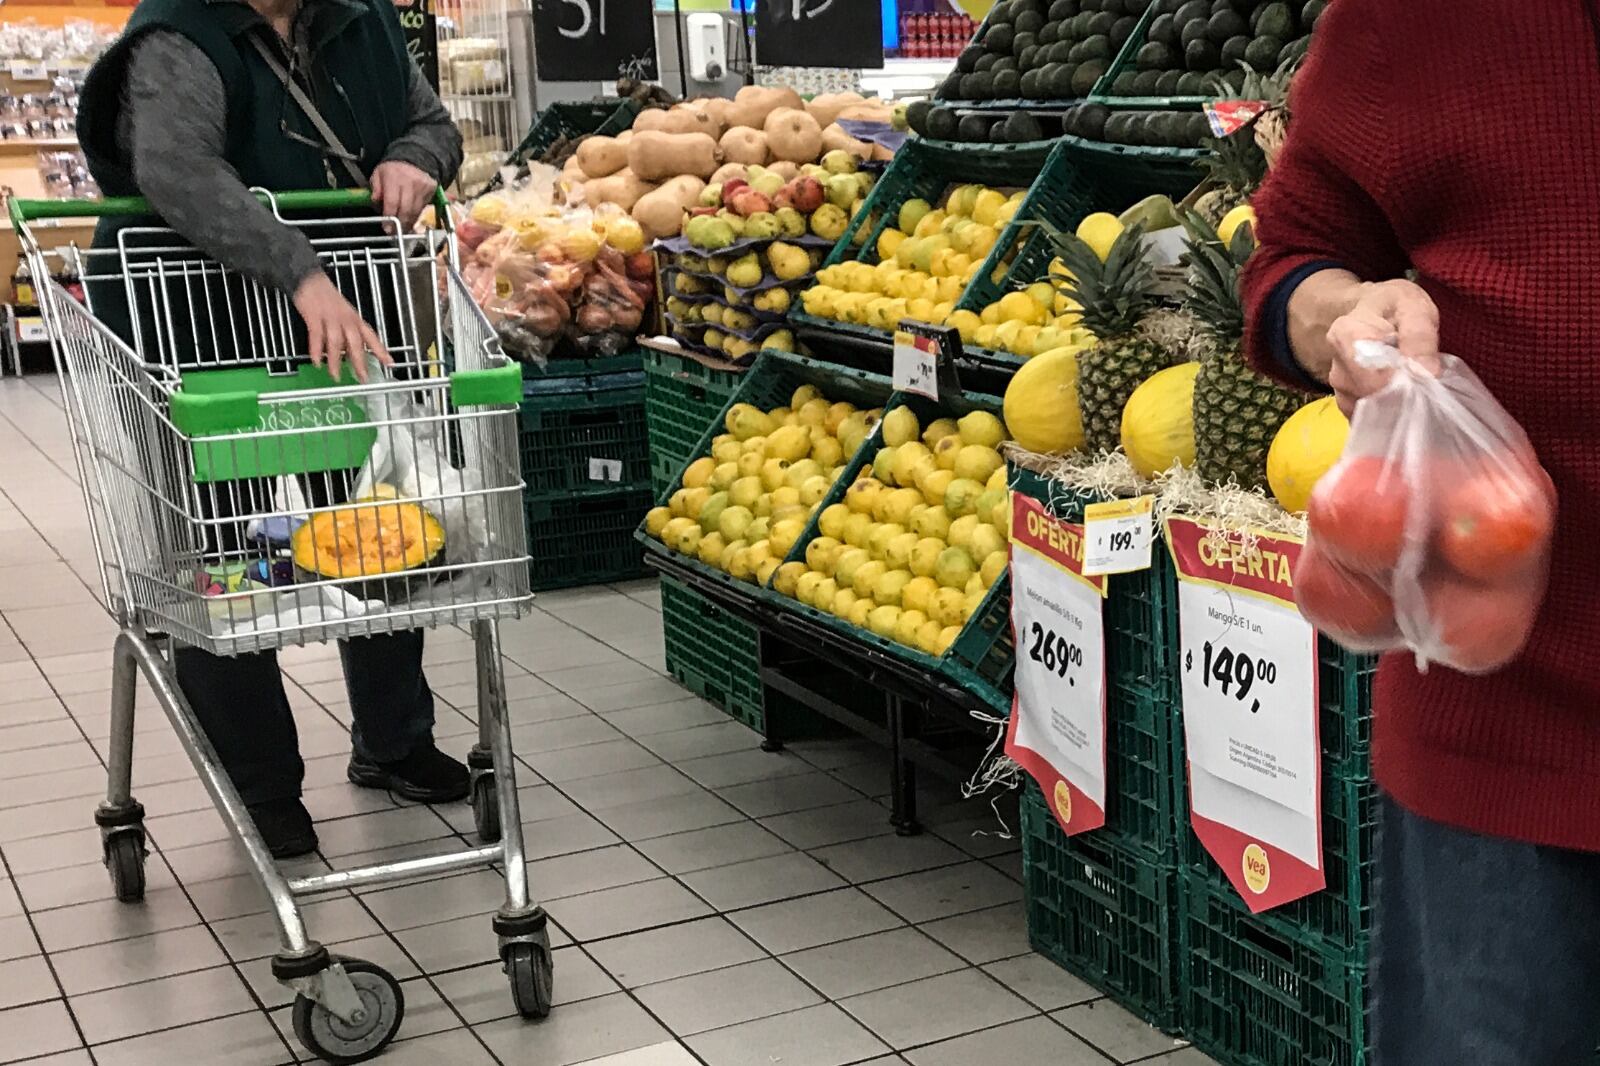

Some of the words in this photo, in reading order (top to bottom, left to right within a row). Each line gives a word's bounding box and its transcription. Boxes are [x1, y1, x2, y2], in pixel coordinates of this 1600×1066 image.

[1198, 536, 1293, 588] OFERTA
[1208, 606, 1233, 625] Mango
[1233, 614, 1245, 629] S/E
[1246, 619, 1250, 630] 1
[1252, 623, 1264, 635] un.
[1185, 647, 1193, 673] $
[1247, 855, 1266, 876] Vea
